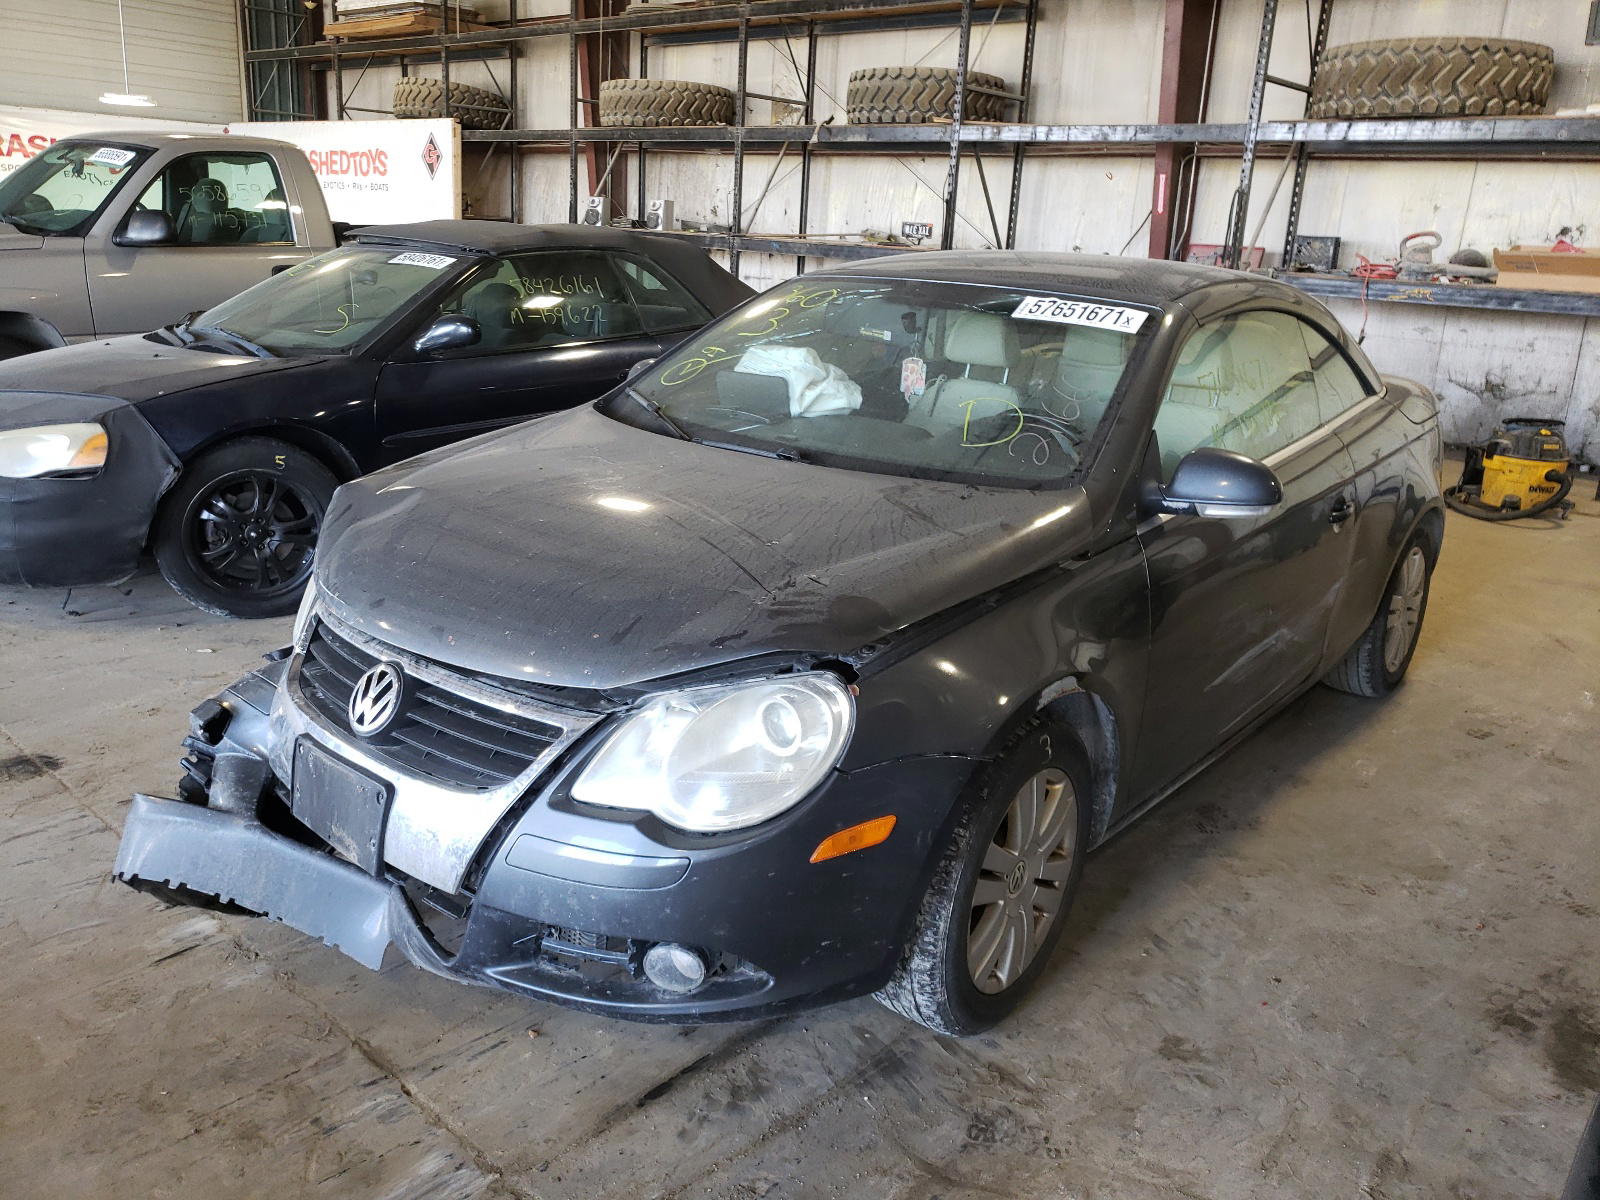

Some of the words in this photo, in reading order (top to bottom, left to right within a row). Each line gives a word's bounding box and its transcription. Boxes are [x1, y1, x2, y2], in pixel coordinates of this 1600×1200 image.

[323, 181, 345, 190] EXOTICS
[370, 183, 389, 192] BOATS
[1028, 299, 1126, 325] 57651671
